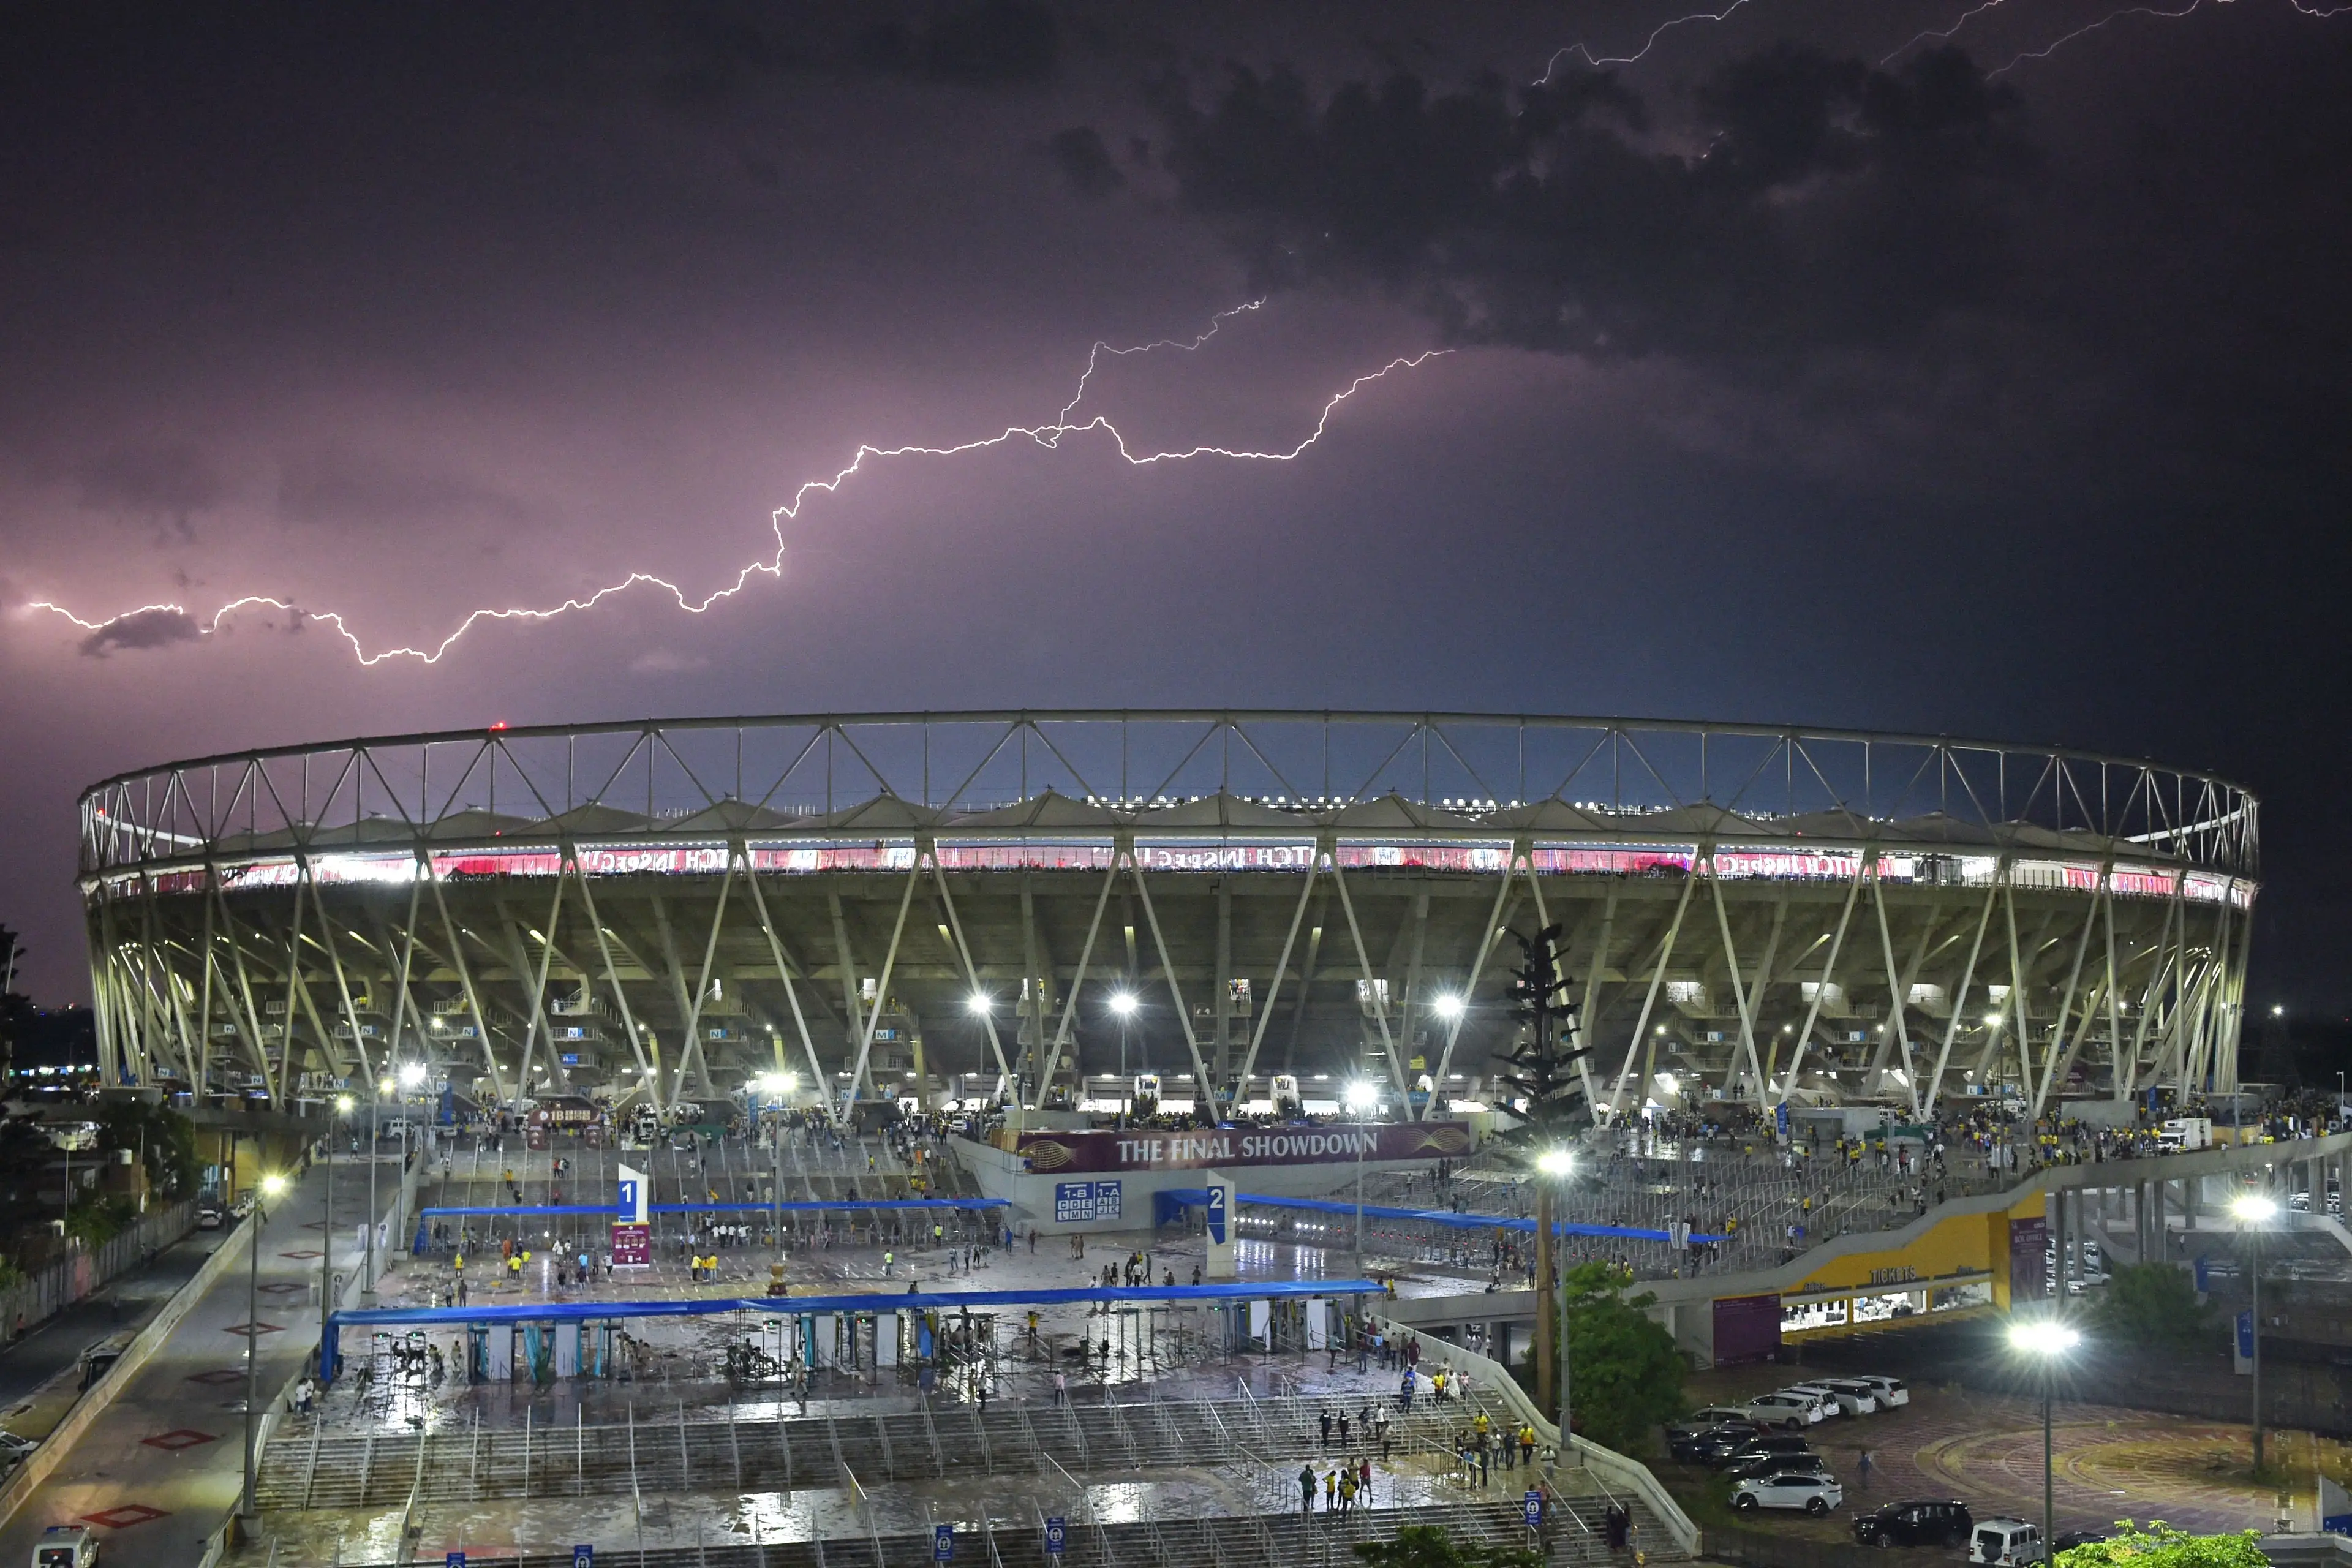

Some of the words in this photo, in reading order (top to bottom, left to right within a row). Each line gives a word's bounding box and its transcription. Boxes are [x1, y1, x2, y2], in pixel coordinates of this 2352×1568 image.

[1117, 1140, 1162, 1163] THE
[1170, 1137, 1235, 1161] FINAL
[1242, 1132, 1378, 1158] SHOWDOWN
[622, 1183, 631, 1203] 1
[1064, 1189, 1087, 1199] 1-B
[1097, 1188, 1120, 1197] 1-A
[1210, 1188, 1223, 1209] 2
[1871, 1265, 1916, 1284] TICKETS
